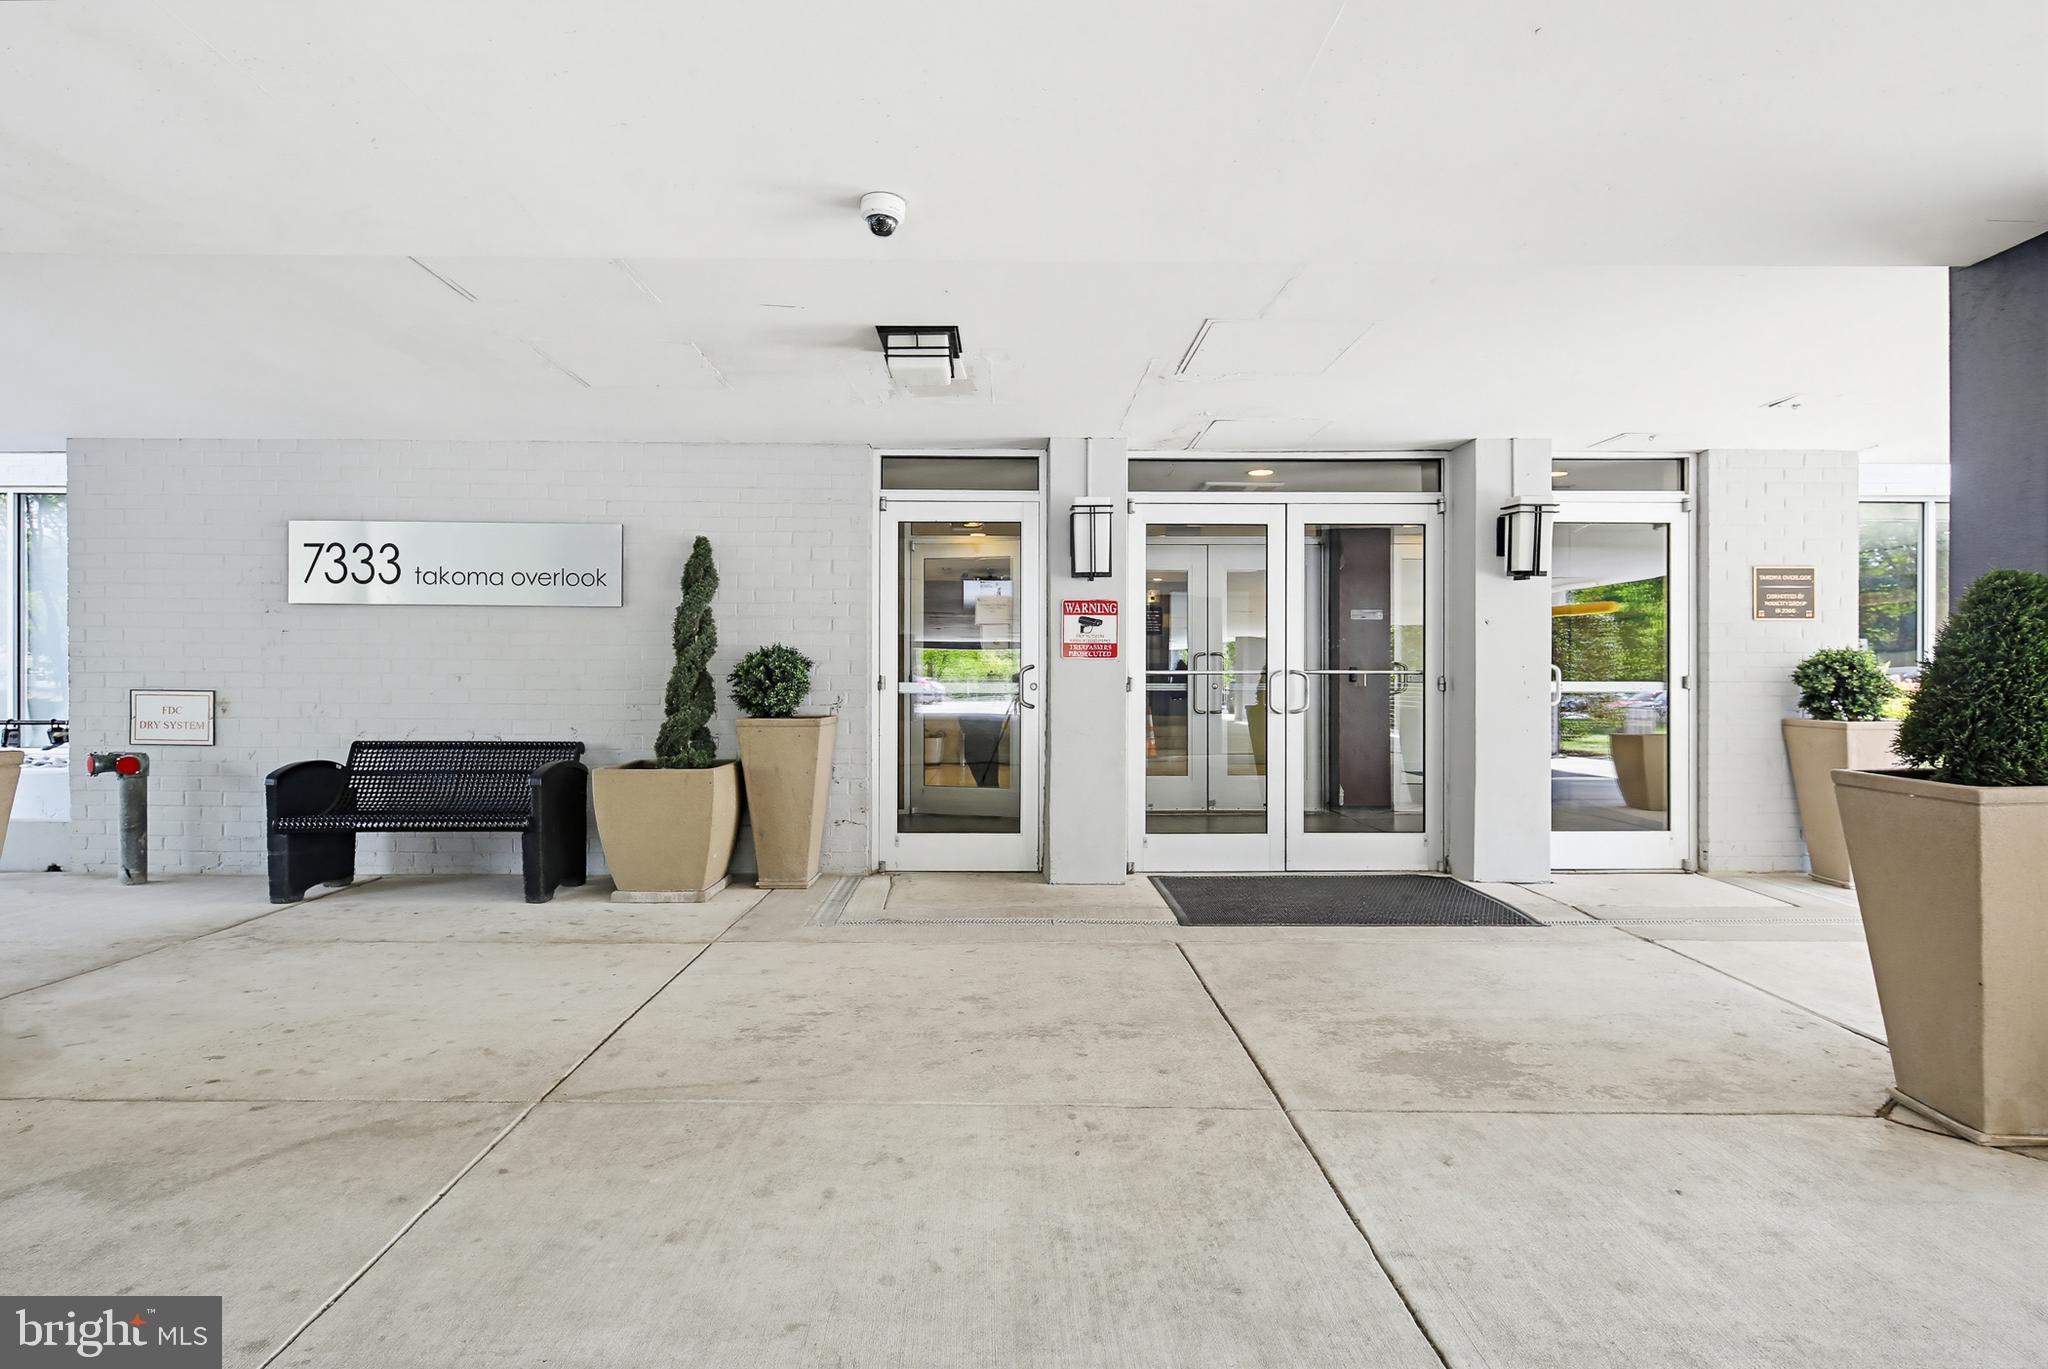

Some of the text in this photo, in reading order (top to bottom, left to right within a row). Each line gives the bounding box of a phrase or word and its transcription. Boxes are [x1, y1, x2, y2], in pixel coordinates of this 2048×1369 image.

[303, 542, 608, 587] 7333 takoma overlook
[1064, 602, 1117, 614] WARNING
[161, 705, 183, 715] FDC
[139, 720, 205, 730] DRY SYSTEM
